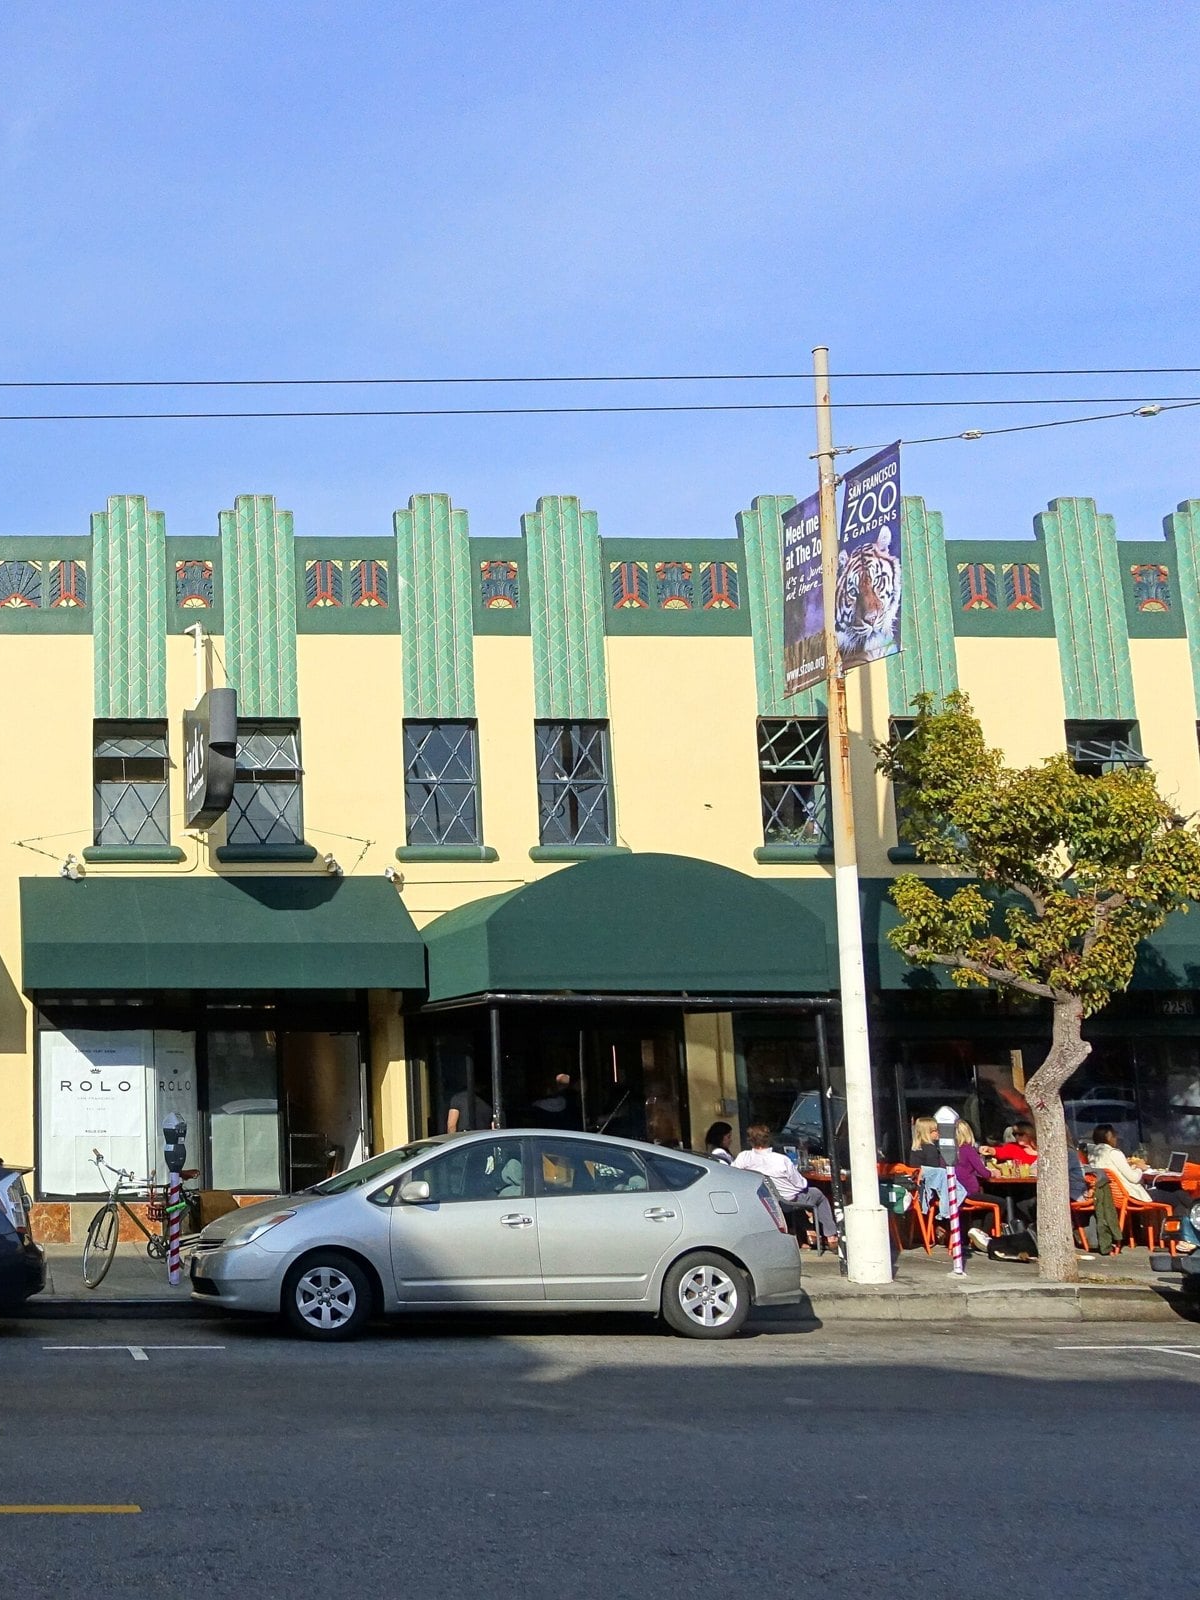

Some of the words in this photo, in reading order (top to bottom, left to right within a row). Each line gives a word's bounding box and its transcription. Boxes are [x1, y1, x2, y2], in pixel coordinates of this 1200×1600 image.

[848, 482, 862, 501] SAN
[862, 462, 897, 493] FRANCISCO
[844, 481, 897, 532] ZOO
[785, 520, 805, 547] Meet
[806, 515, 819, 535] me
[852, 509, 897, 538] GARDENS
[785, 550, 794, 571] at
[795, 544, 811, 565] The
[812, 537, 822, 558] Zo
[60, 1081, 131, 1092] ROLO
[159, 1081, 191, 1091] ROLO
